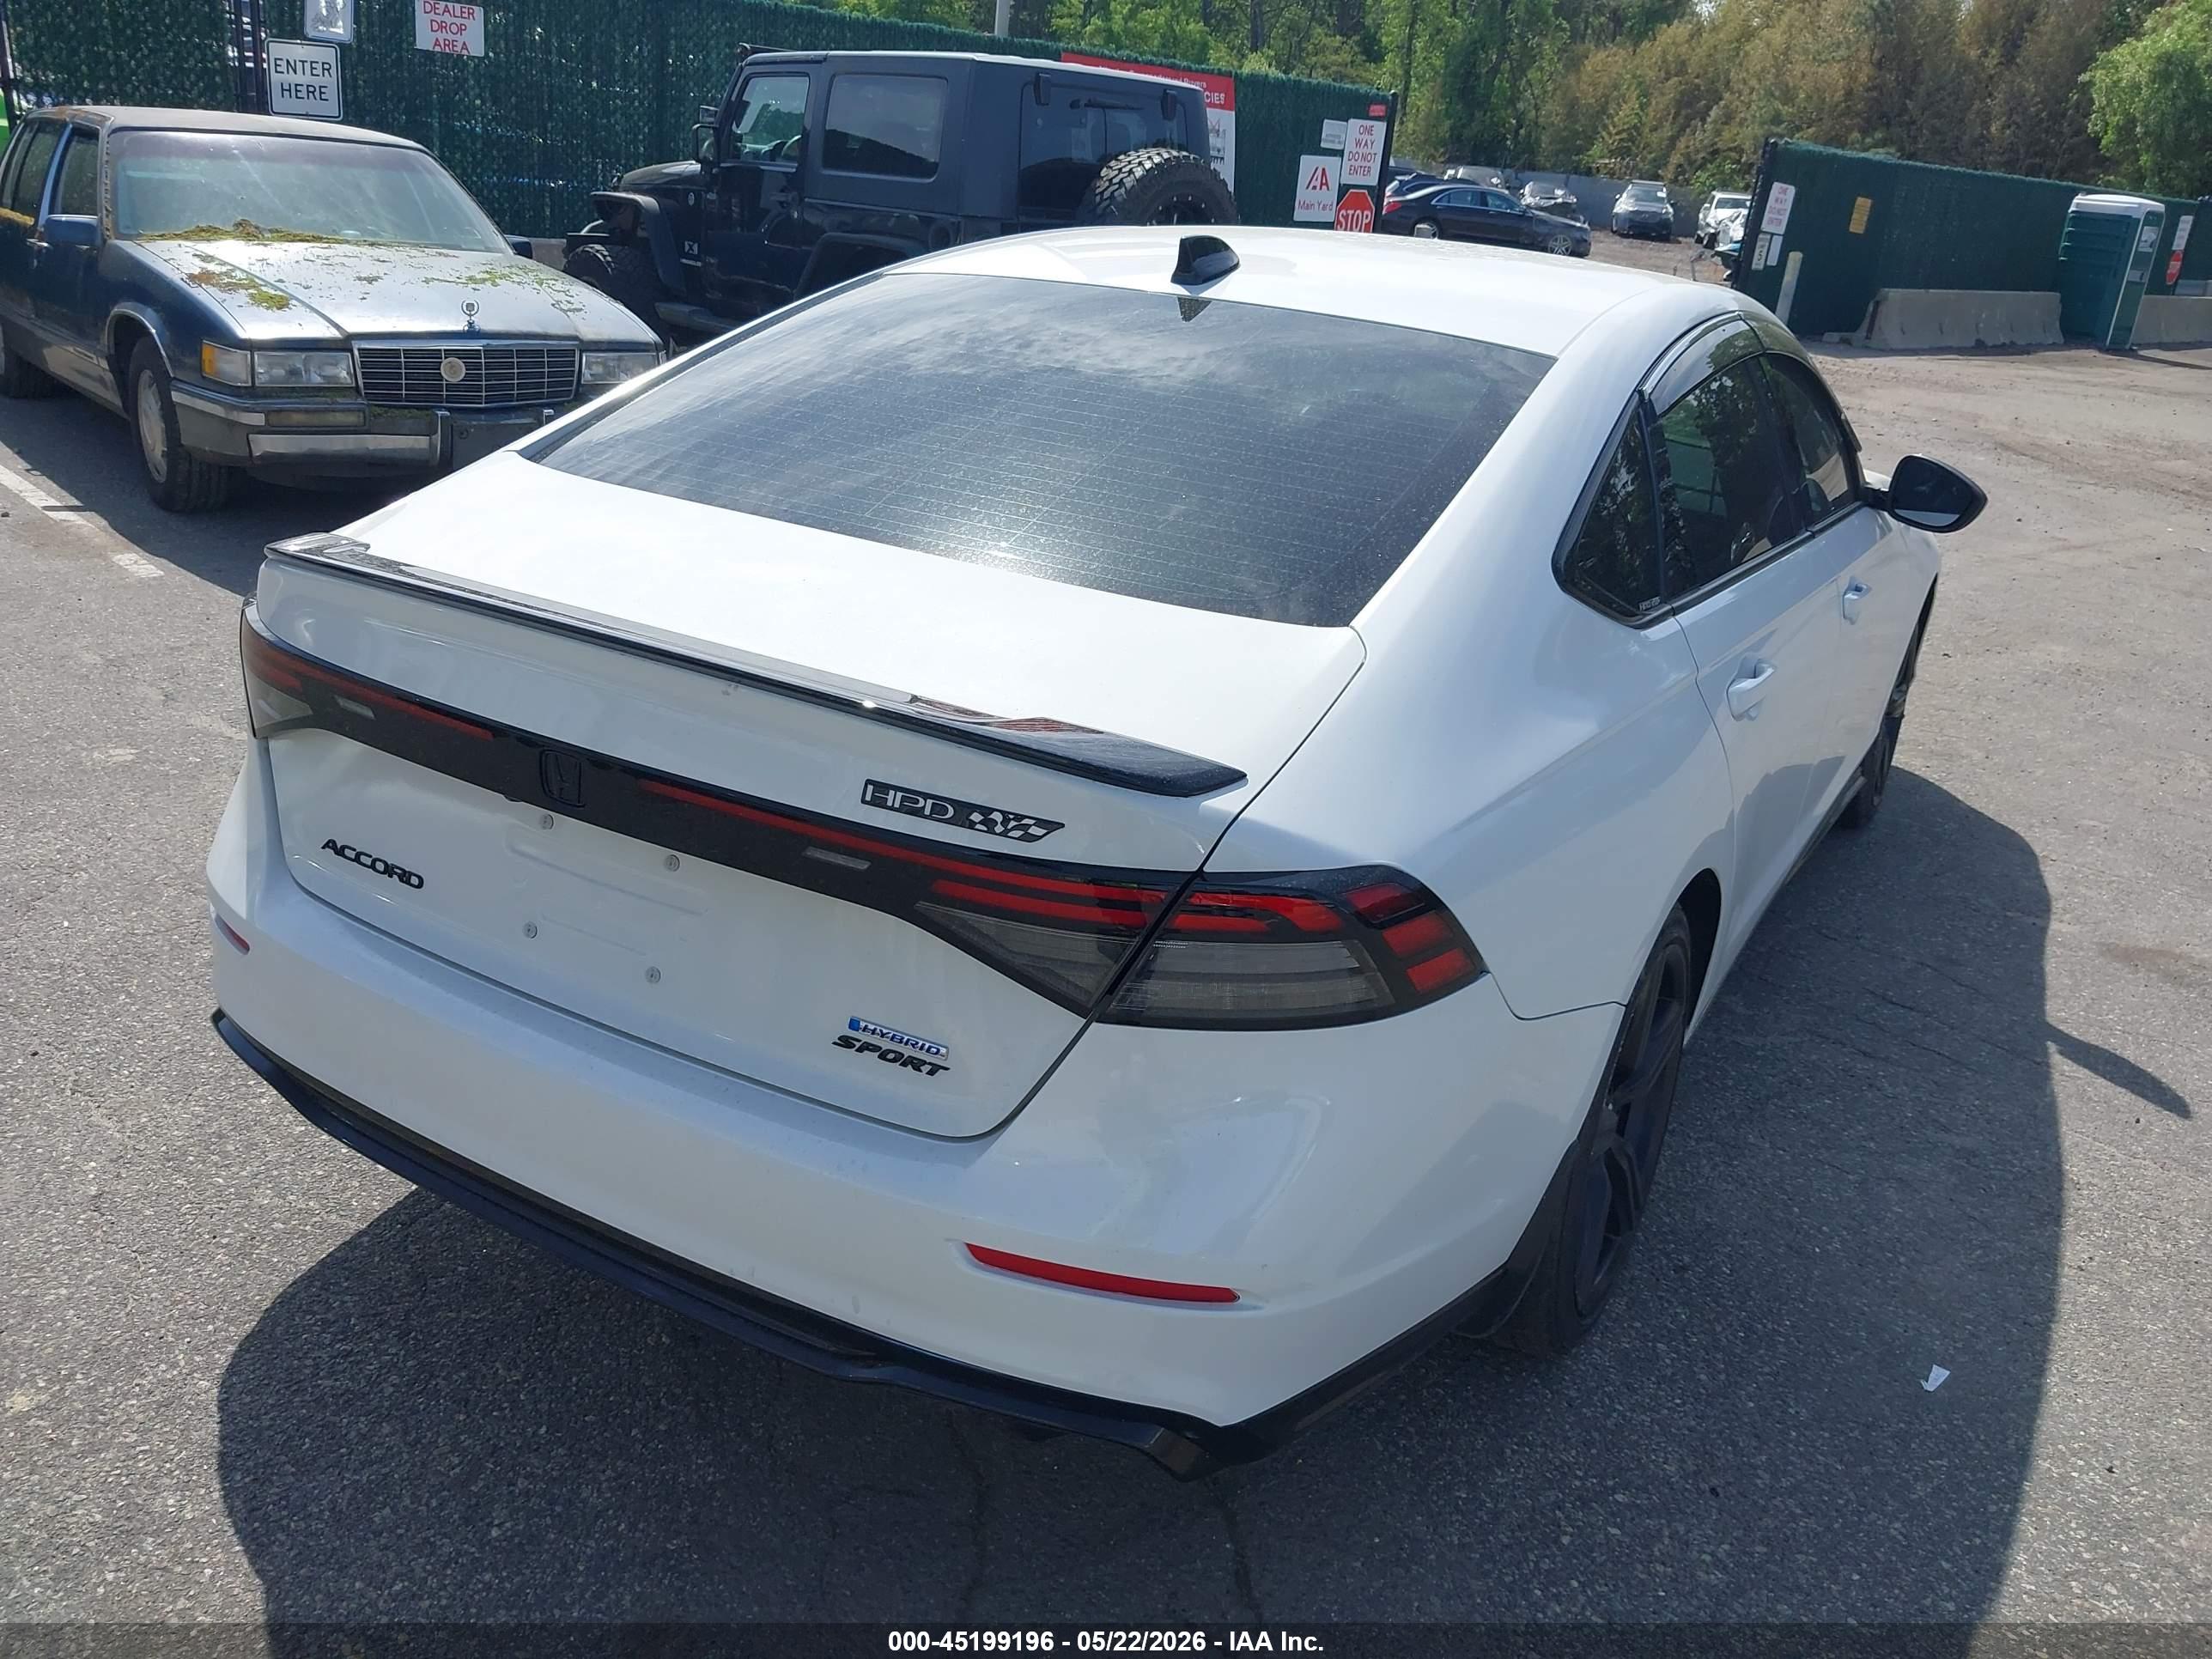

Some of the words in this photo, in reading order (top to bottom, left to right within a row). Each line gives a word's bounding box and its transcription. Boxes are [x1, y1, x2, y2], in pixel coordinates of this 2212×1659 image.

[423, 0, 476, 21] DEALER
[430, 20, 467, 36] DROP
[432, 38, 471, 55] AREA
[274, 58, 332, 78] ENTER
[280, 82, 330, 101] HERE
[1358, 125, 1374, 136] ONE
[1355, 138, 1375, 149] WAY
[1347, 151, 1360, 161] DO
[1361, 152, 1377, 163] NOT
[1348, 165, 1371, 177] ENTER
[1297, 198, 1316, 210] Main
[1316, 201, 1334, 212] Yard
[1337, 210, 1371, 234] STOP
[865, 784, 955, 819] HPD
[320, 838, 424, 890] ACCORD
[860, 1024, 941, 1056] HYBRID
[831, 1034, 951, 1077] SPORT
